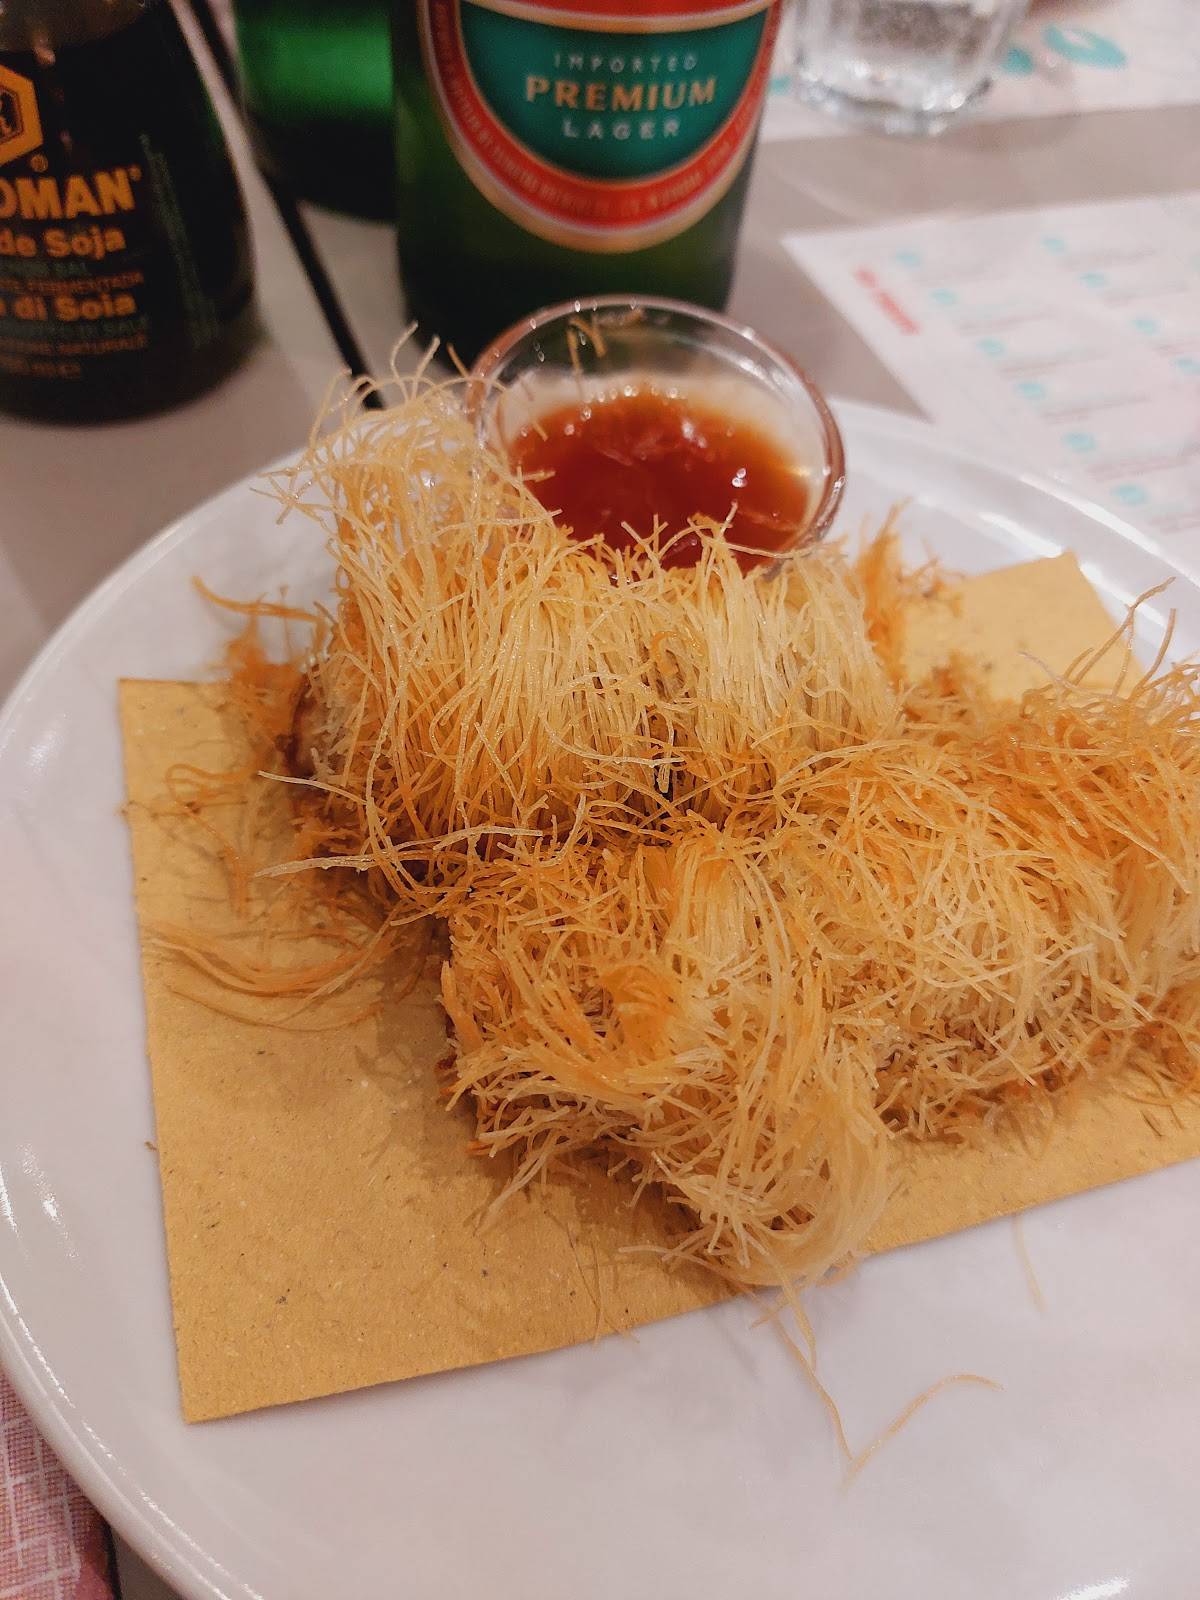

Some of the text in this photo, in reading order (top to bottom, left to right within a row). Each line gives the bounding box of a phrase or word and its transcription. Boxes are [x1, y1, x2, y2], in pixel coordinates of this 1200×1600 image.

[553, 51, 699, 74] IMPORTED
[525, 75, 717, 112] PREMIUM
[562, 117, 681, 141] LAGER
[43, 225, 127, 260] Soja
[55, 291, 137, 322] Soia
